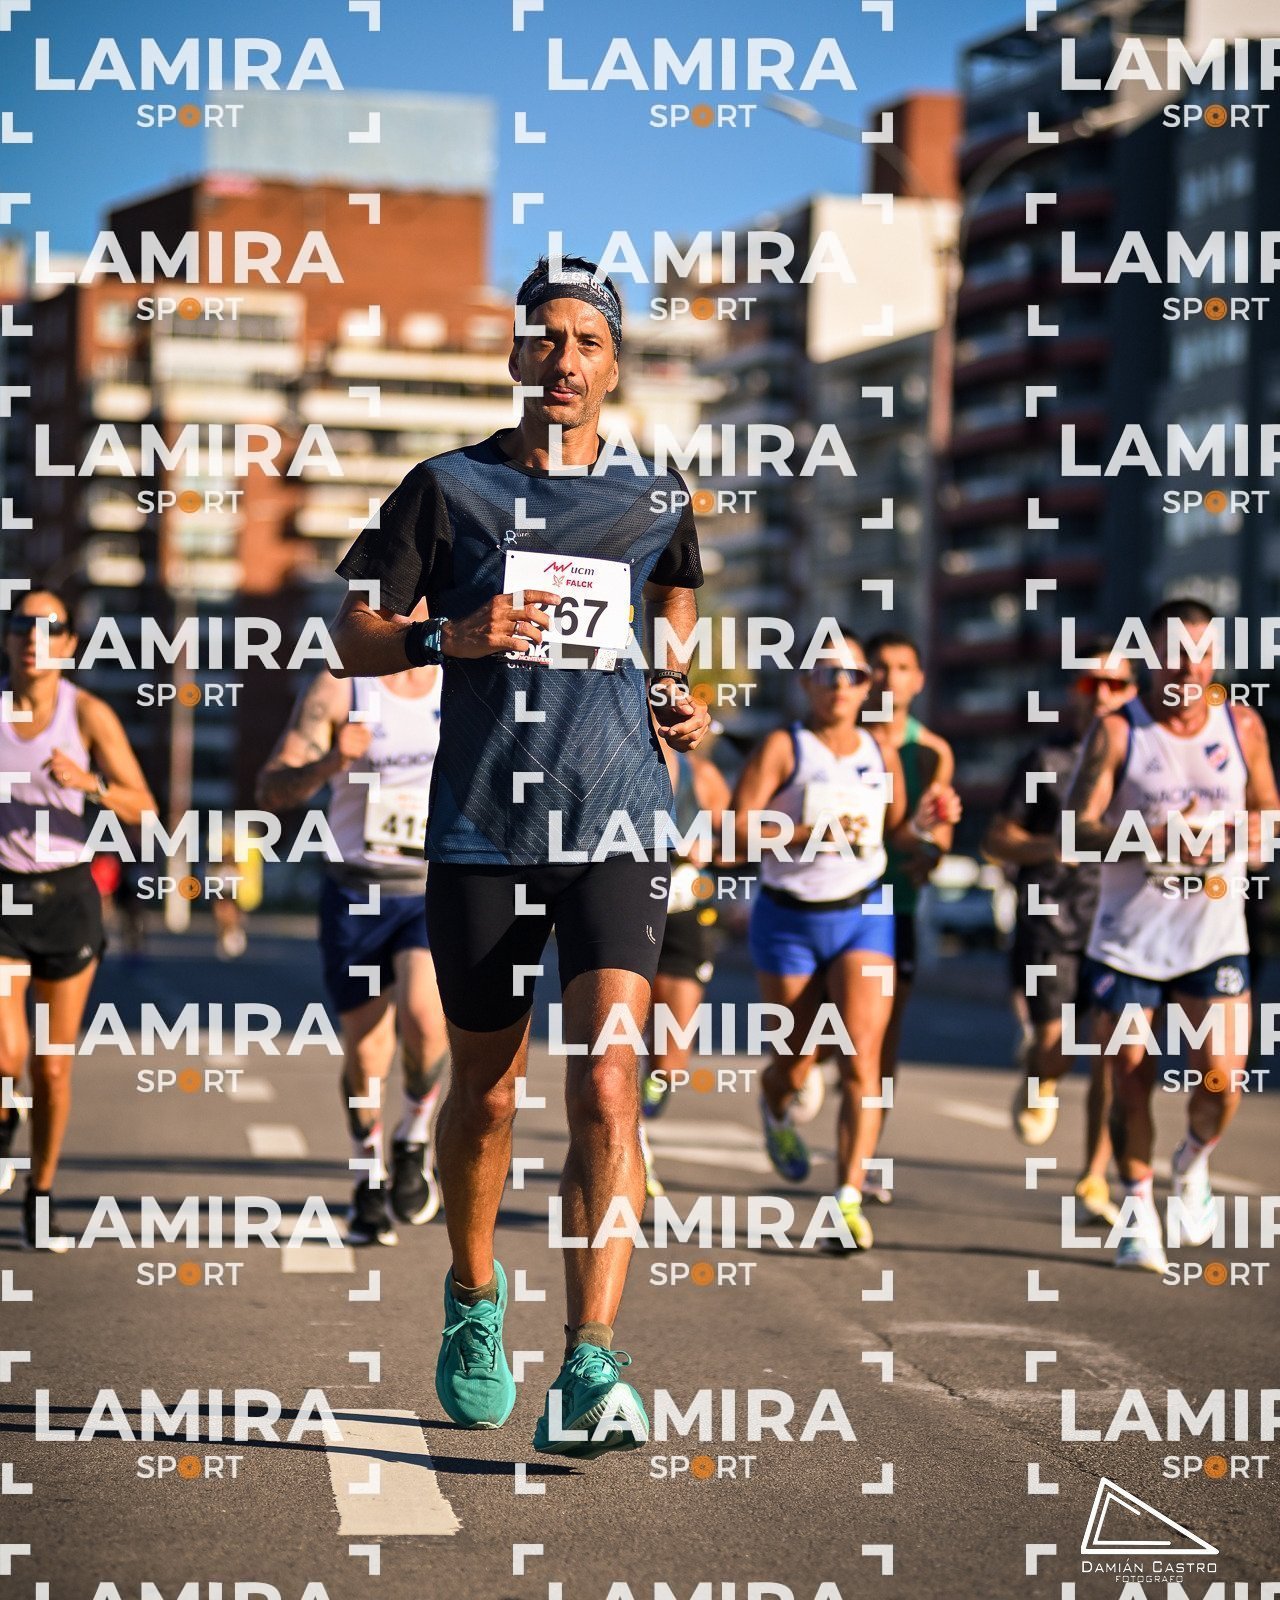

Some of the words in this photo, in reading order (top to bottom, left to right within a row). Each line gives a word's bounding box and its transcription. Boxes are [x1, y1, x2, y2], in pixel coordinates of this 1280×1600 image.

[571, 567, 595, 576] ucm
[566, 579, 593, 588] FALCK
[530, 596, 608, 638] 67
